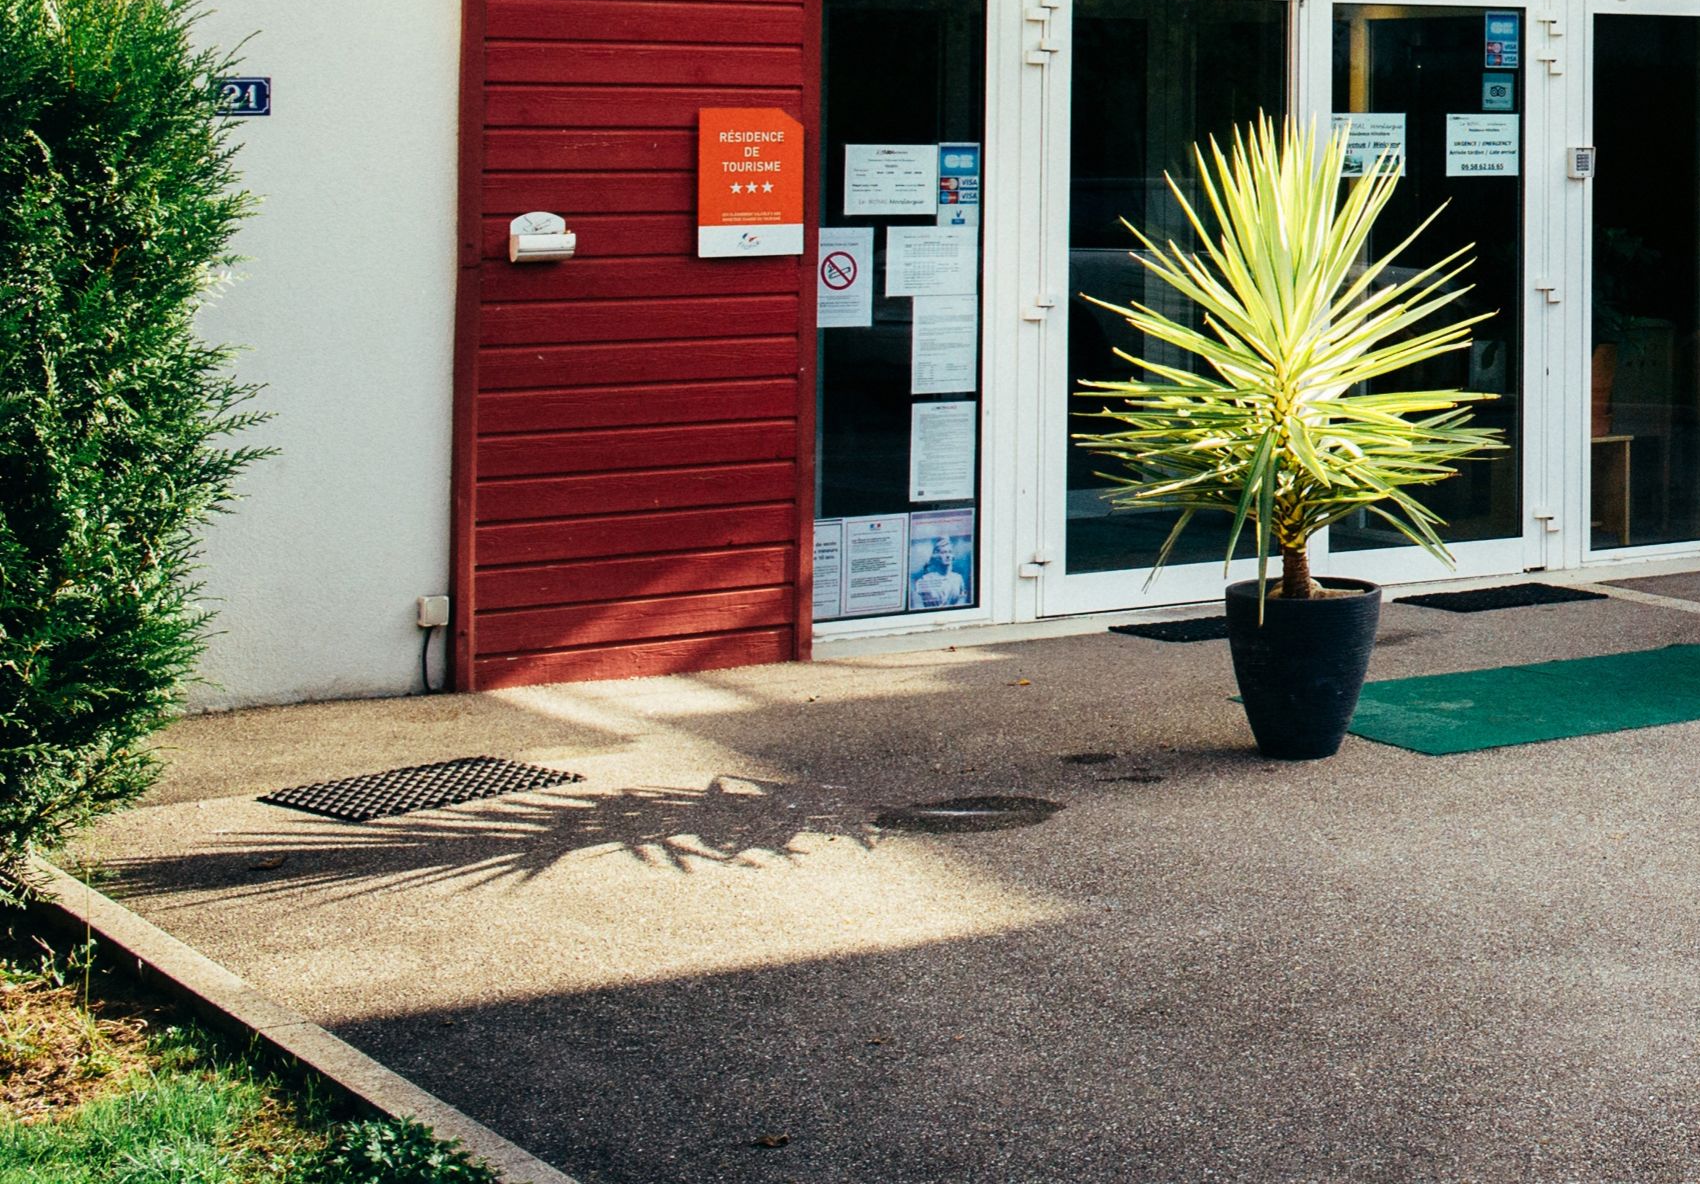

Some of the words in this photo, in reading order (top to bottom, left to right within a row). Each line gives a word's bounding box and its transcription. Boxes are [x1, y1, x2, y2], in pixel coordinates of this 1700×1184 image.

[220, 84, 258, 109] 21
[719, 129, 785, 143] RÉSIDENCE
[744, 146, 760, 158] DE
[722, 161, 782, 173] TOURISME
[961, 192, 978, 200] VISA
